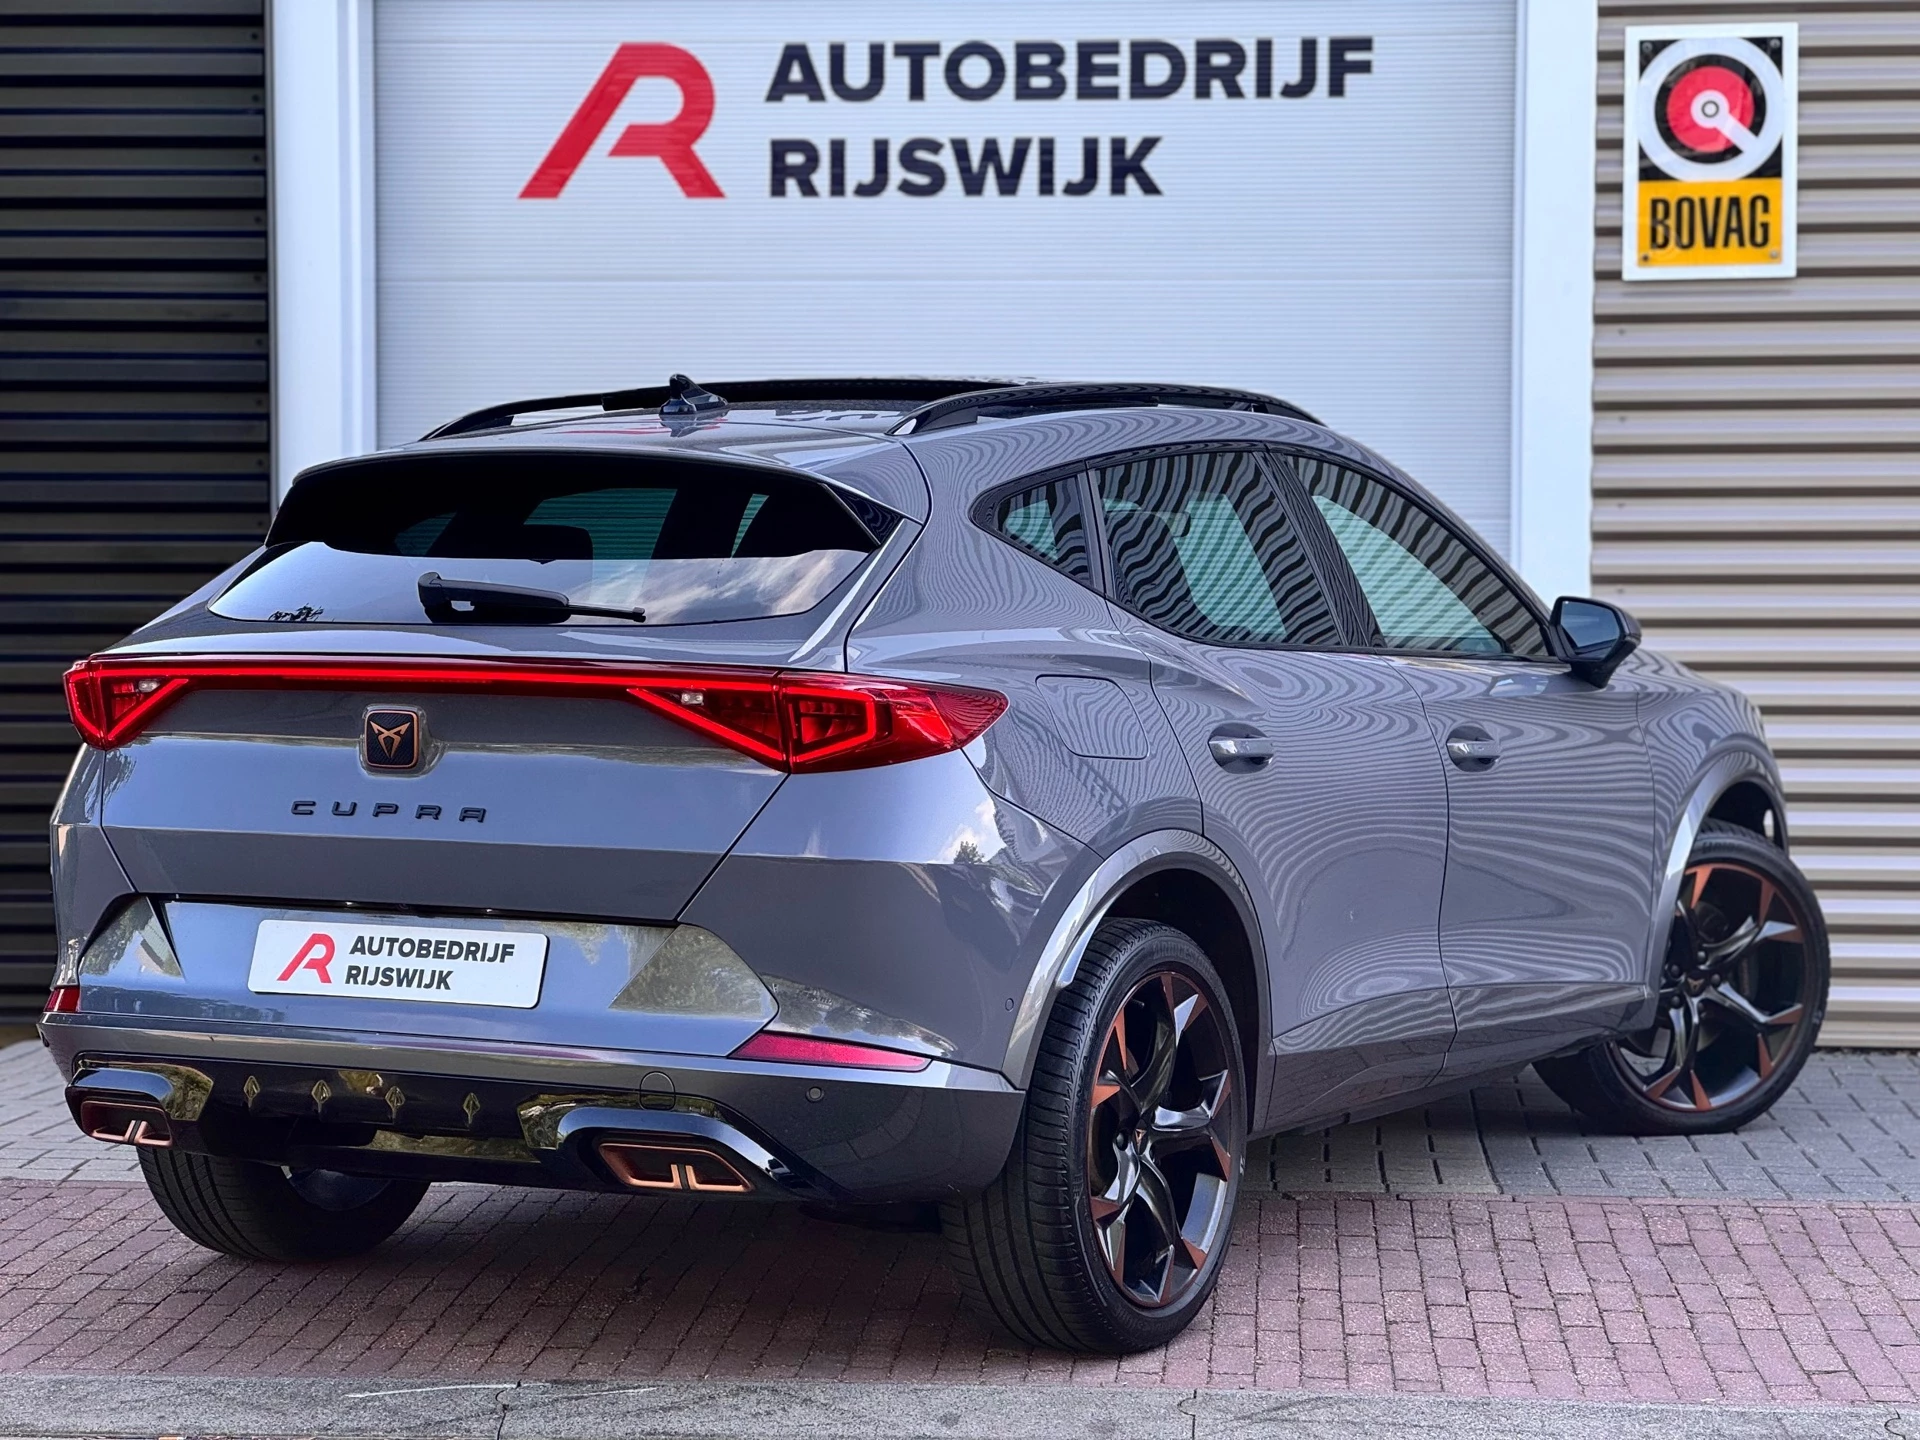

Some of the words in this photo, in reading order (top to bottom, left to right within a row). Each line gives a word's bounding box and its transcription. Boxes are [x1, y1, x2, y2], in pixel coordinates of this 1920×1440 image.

[765, 37, 1374, 102] AUTOBEDRIJF
[769, 137, 1163, 198] RIJSWIJK
[1650, 194, 1770, 249] BOVAG
[291, 800, 486, 823] CUPRA
[349, 935, 515, 964] AUTOBEDRIJF
[345, 964, 454, 991] RIJSWIJK
